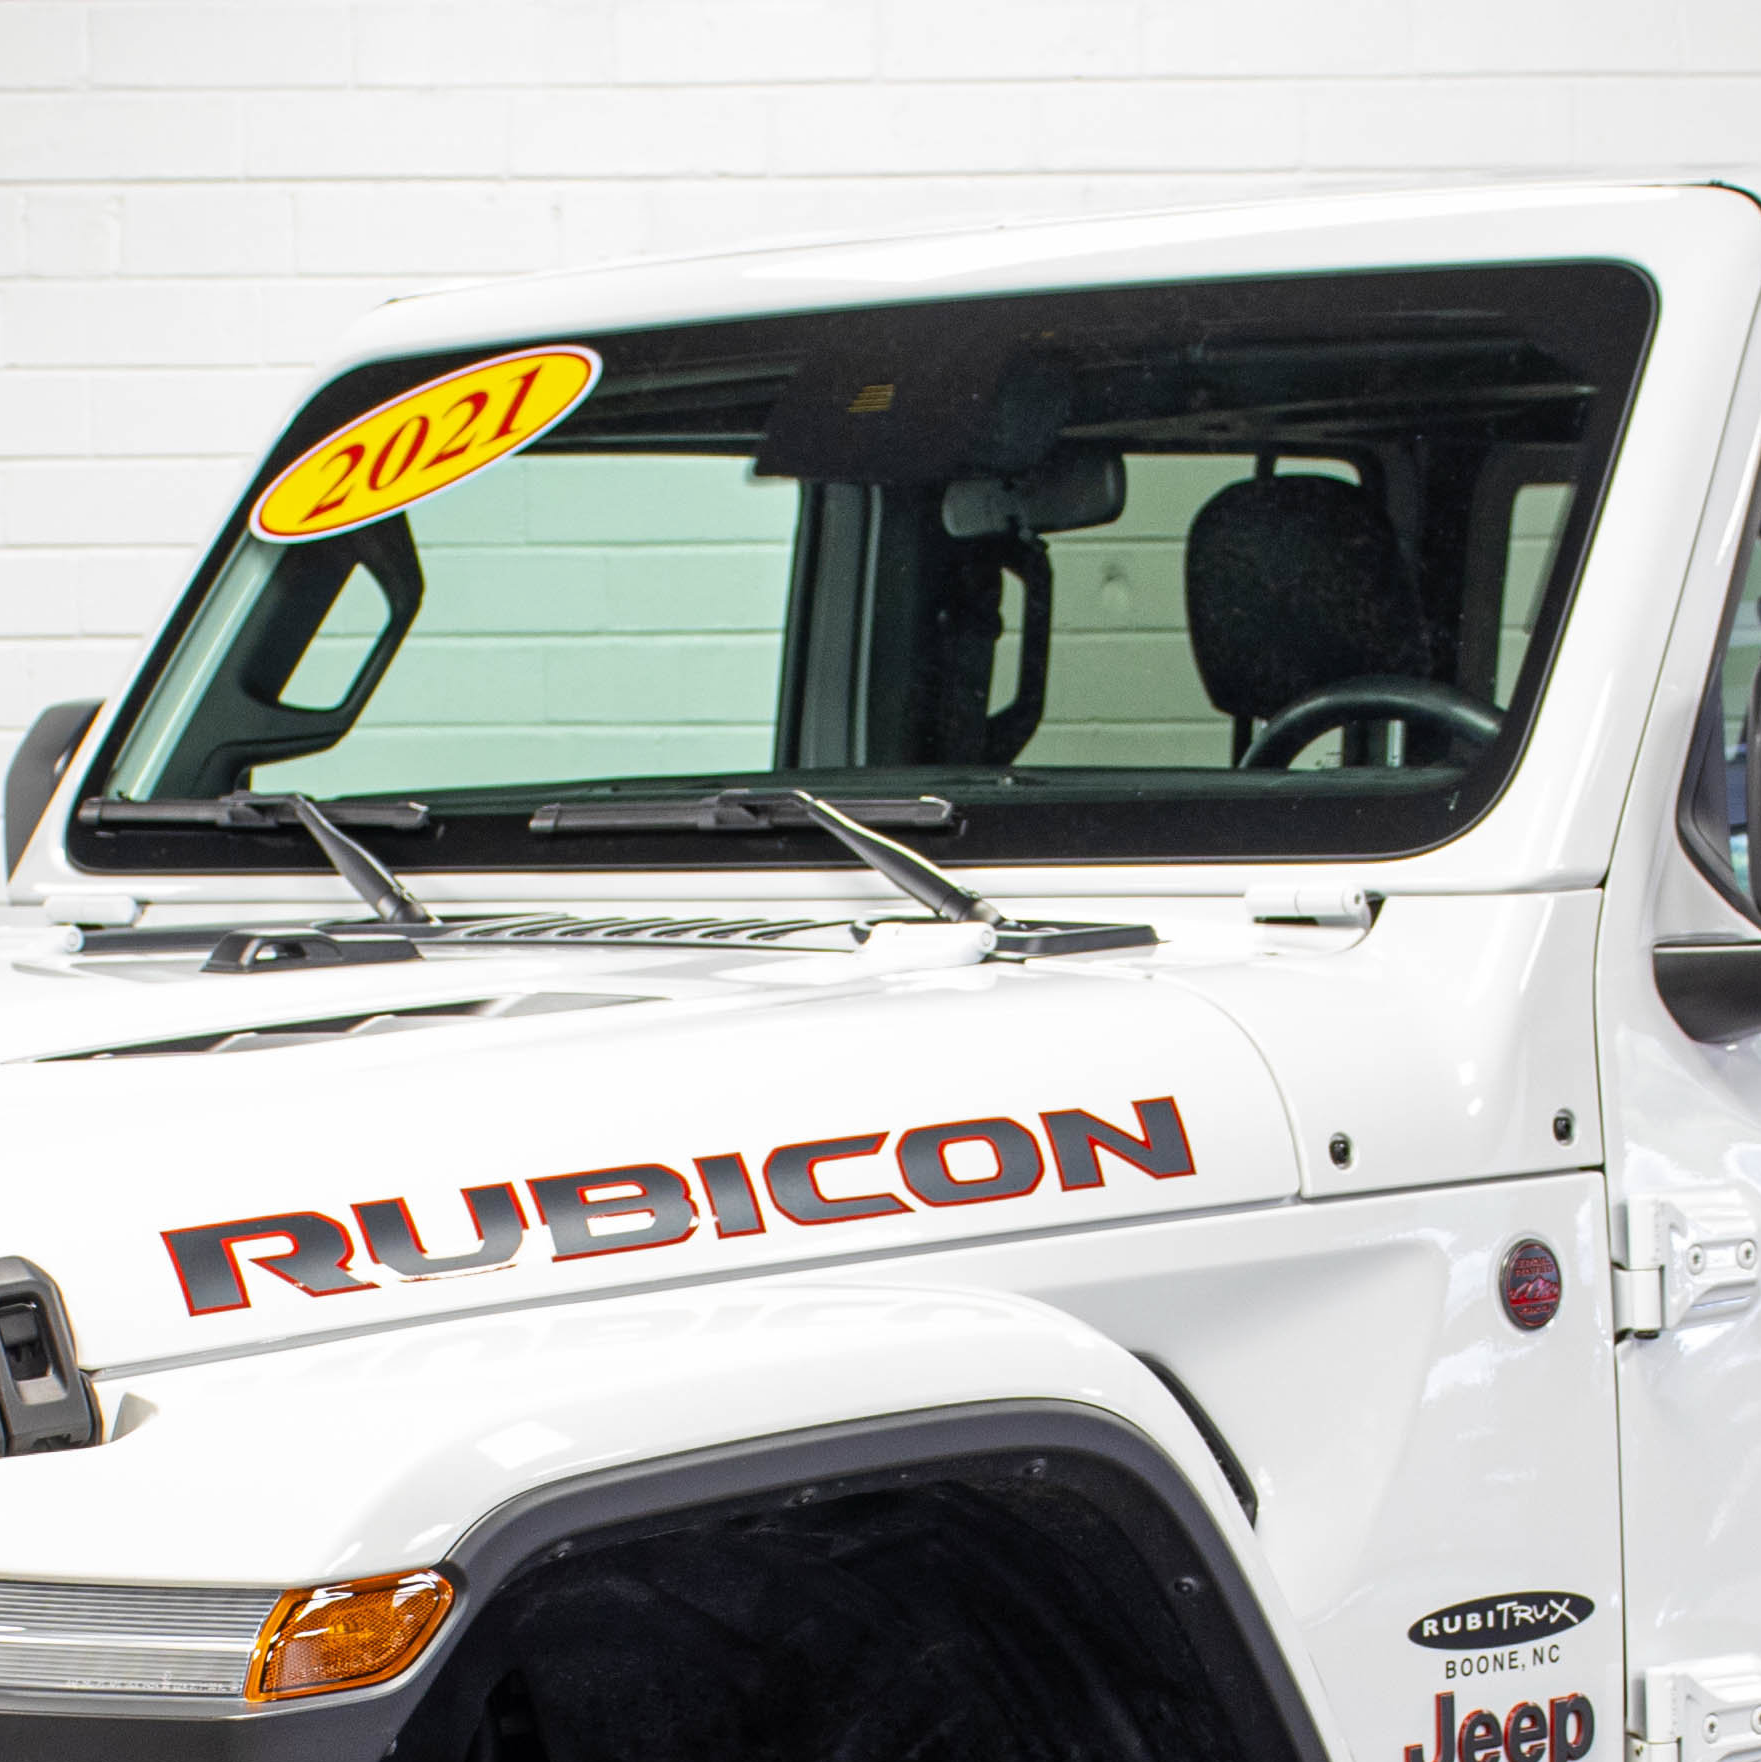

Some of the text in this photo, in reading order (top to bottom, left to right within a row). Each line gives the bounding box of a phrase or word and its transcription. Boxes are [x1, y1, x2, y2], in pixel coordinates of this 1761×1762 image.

[298, 362, 543, 526] 2021
[160, 1095, 1197, 1316] RUBICON
[1444, 1644, 1561, 1679] BOONE, NC
